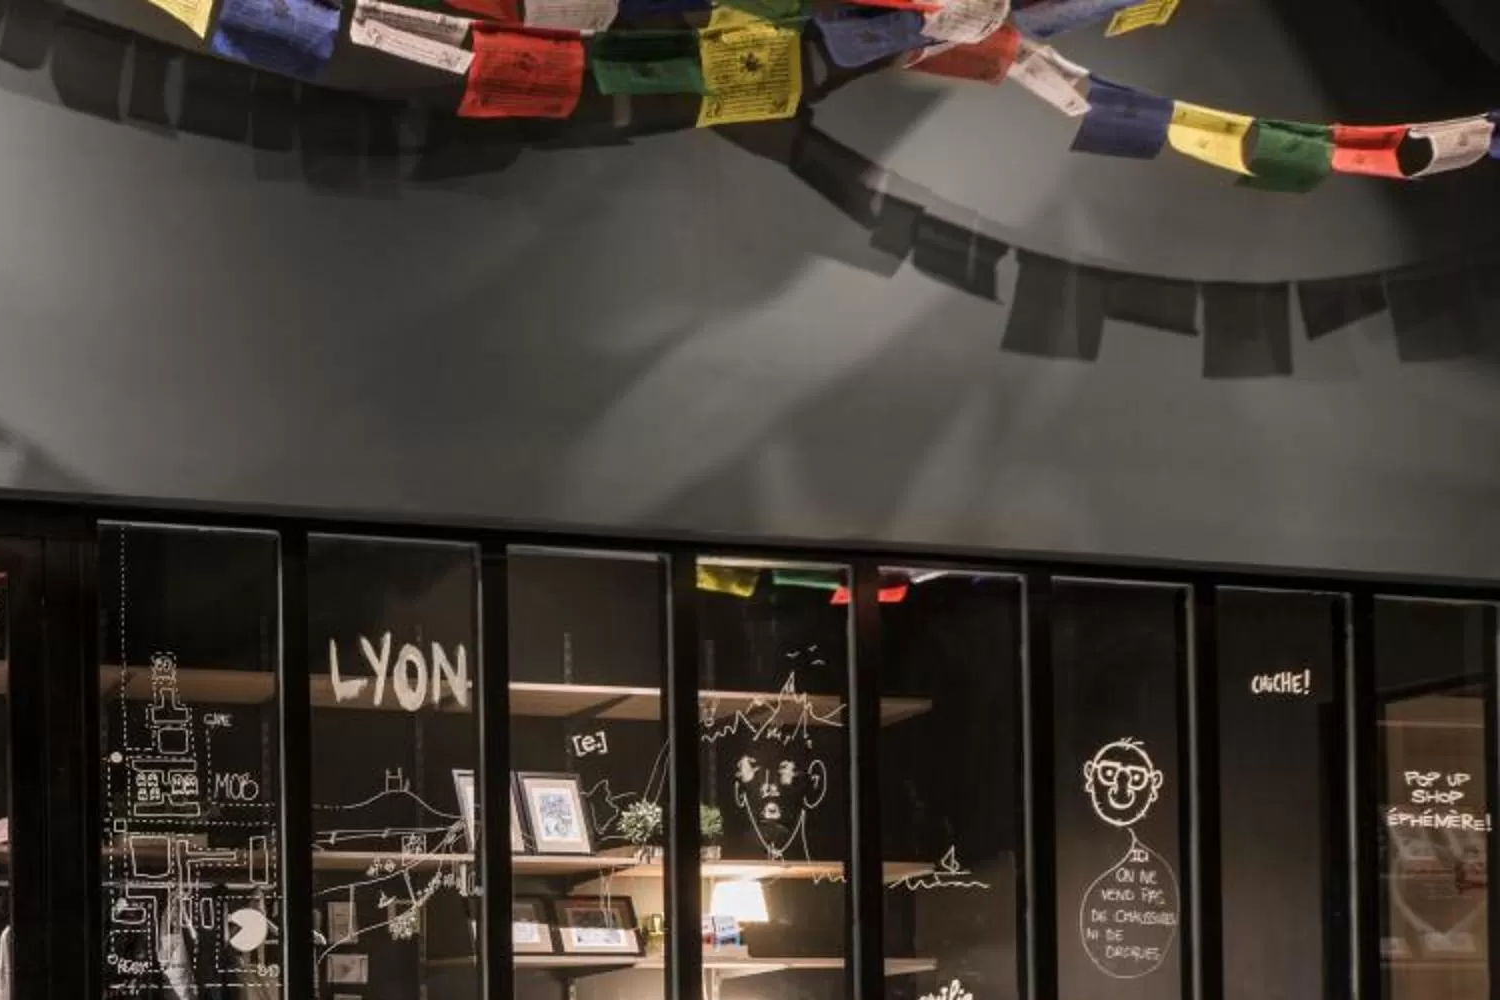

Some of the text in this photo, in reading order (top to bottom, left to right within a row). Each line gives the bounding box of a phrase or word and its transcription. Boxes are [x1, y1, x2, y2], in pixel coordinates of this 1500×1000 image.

[328, 630, 473, 713] LYON
[214, 772, 260, 801] MOB
[1404, 770, 1472, 787] POP UP
[1411, 788, 1465, 805] SHOP
